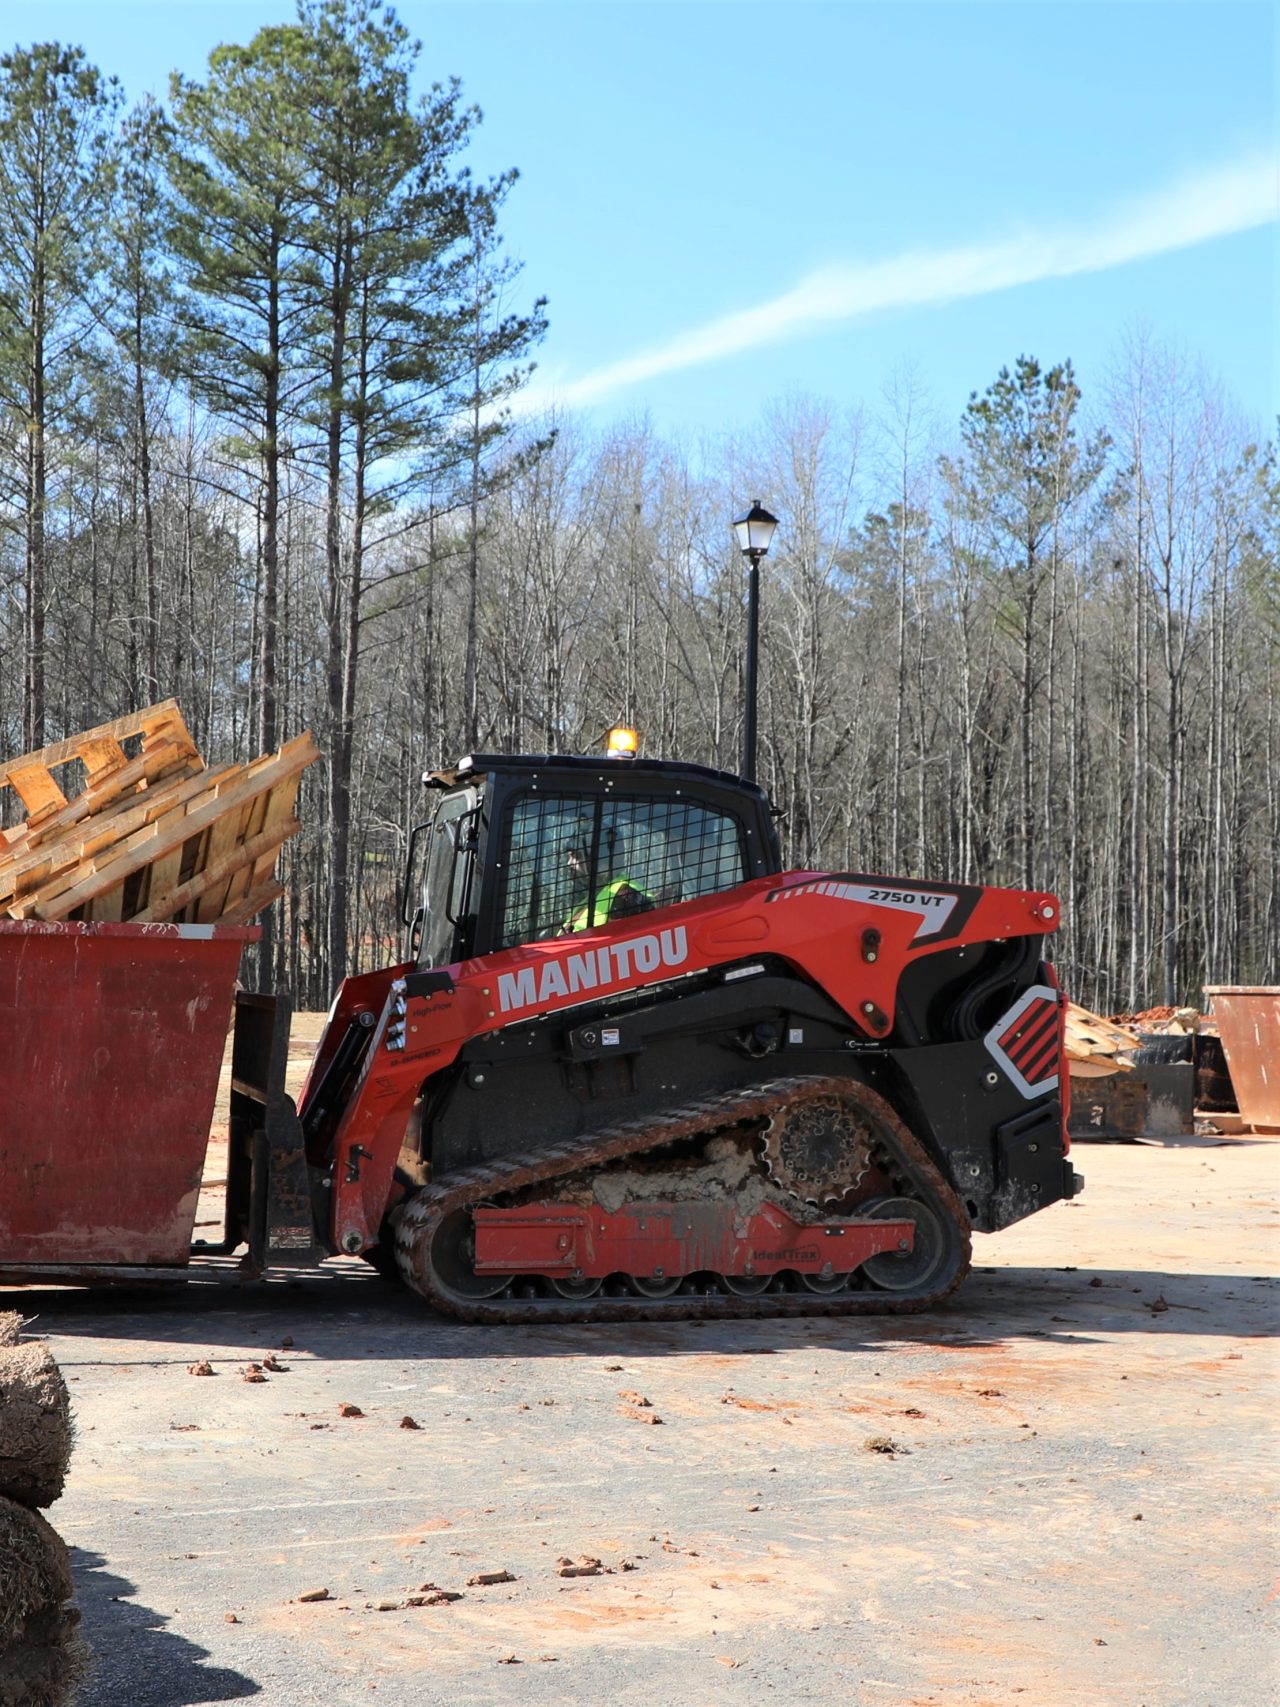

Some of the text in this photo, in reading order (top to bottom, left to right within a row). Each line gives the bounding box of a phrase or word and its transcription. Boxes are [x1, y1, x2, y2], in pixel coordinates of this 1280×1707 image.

[868, 890, 945, 907] 2750 VT
[497, 925, 689, 1012] MANITOU
